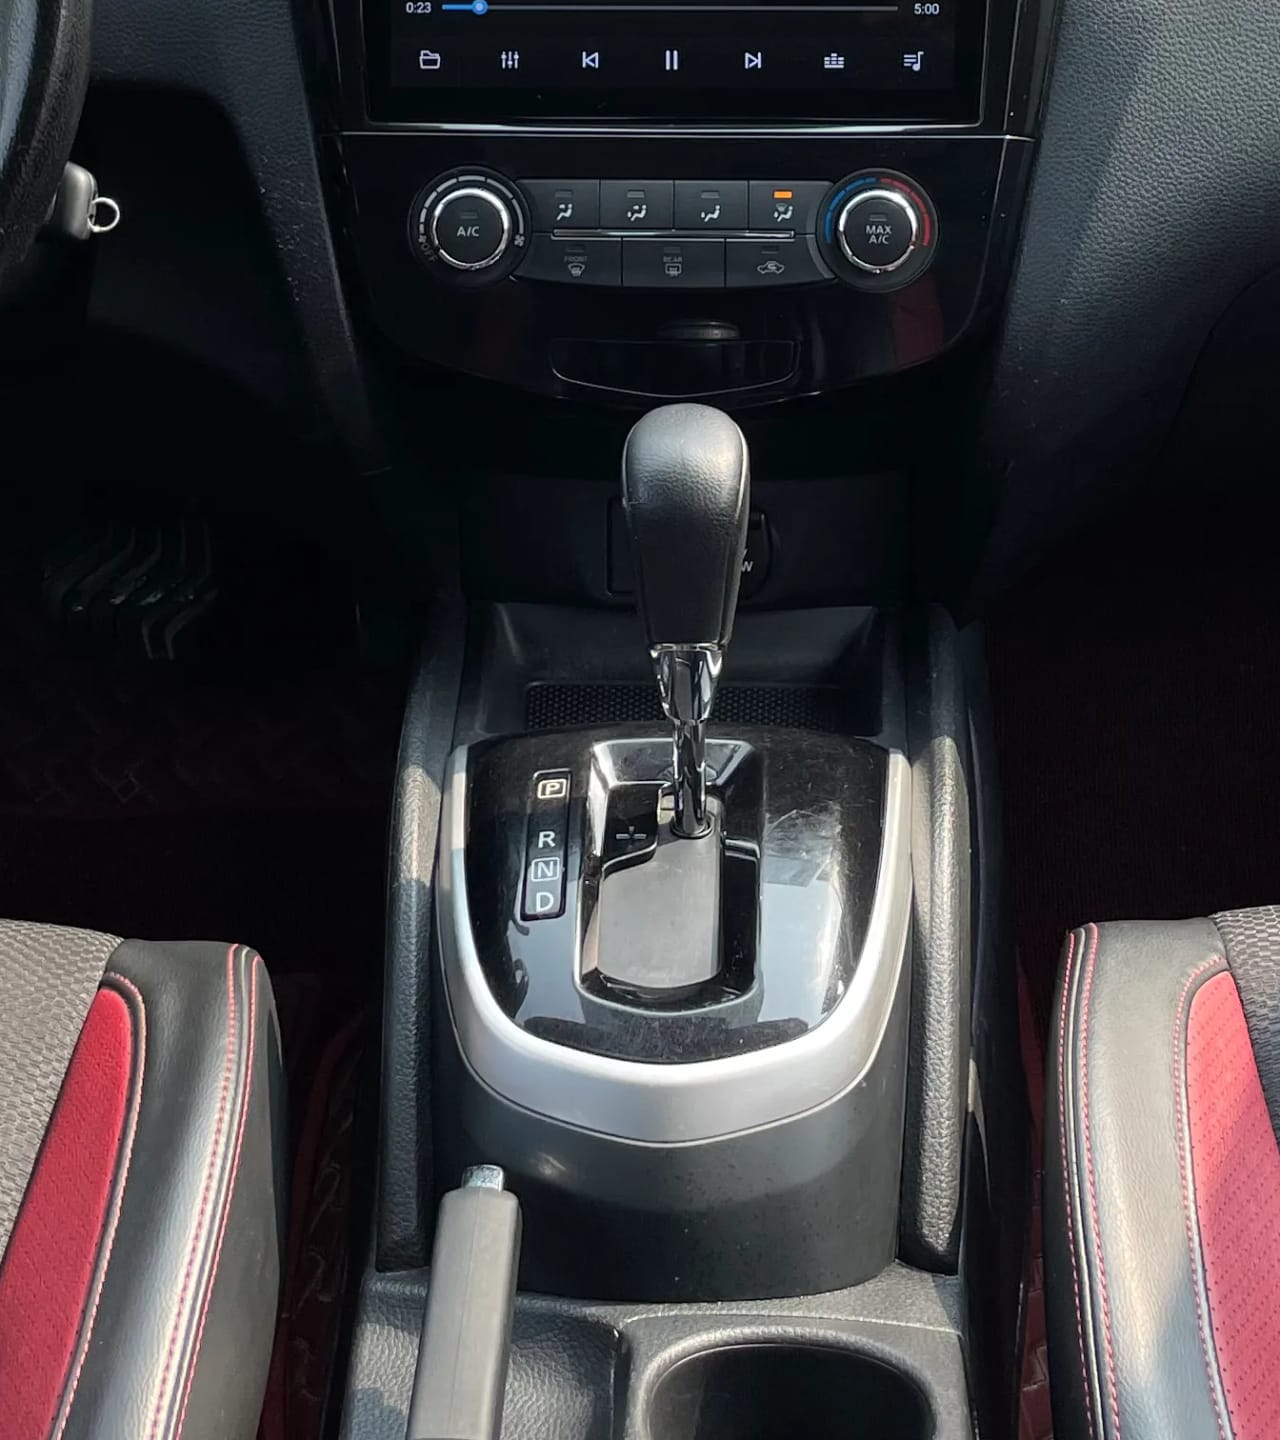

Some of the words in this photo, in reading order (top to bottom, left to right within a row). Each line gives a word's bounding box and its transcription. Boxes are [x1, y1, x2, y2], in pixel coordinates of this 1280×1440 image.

[405, 1, 432, 14] 0:23
[913, 3, 940, 15] 5:00
[456, 226, 480, 237] A/C
[865, 225, 892, 235] MAX
[868, 234, 889, 245] A/C
[545, 783, 561, 796] P
[537, 830, 556, 849] R
[537, 861, 554, 878] N
[535, 891, 555, 913] D
